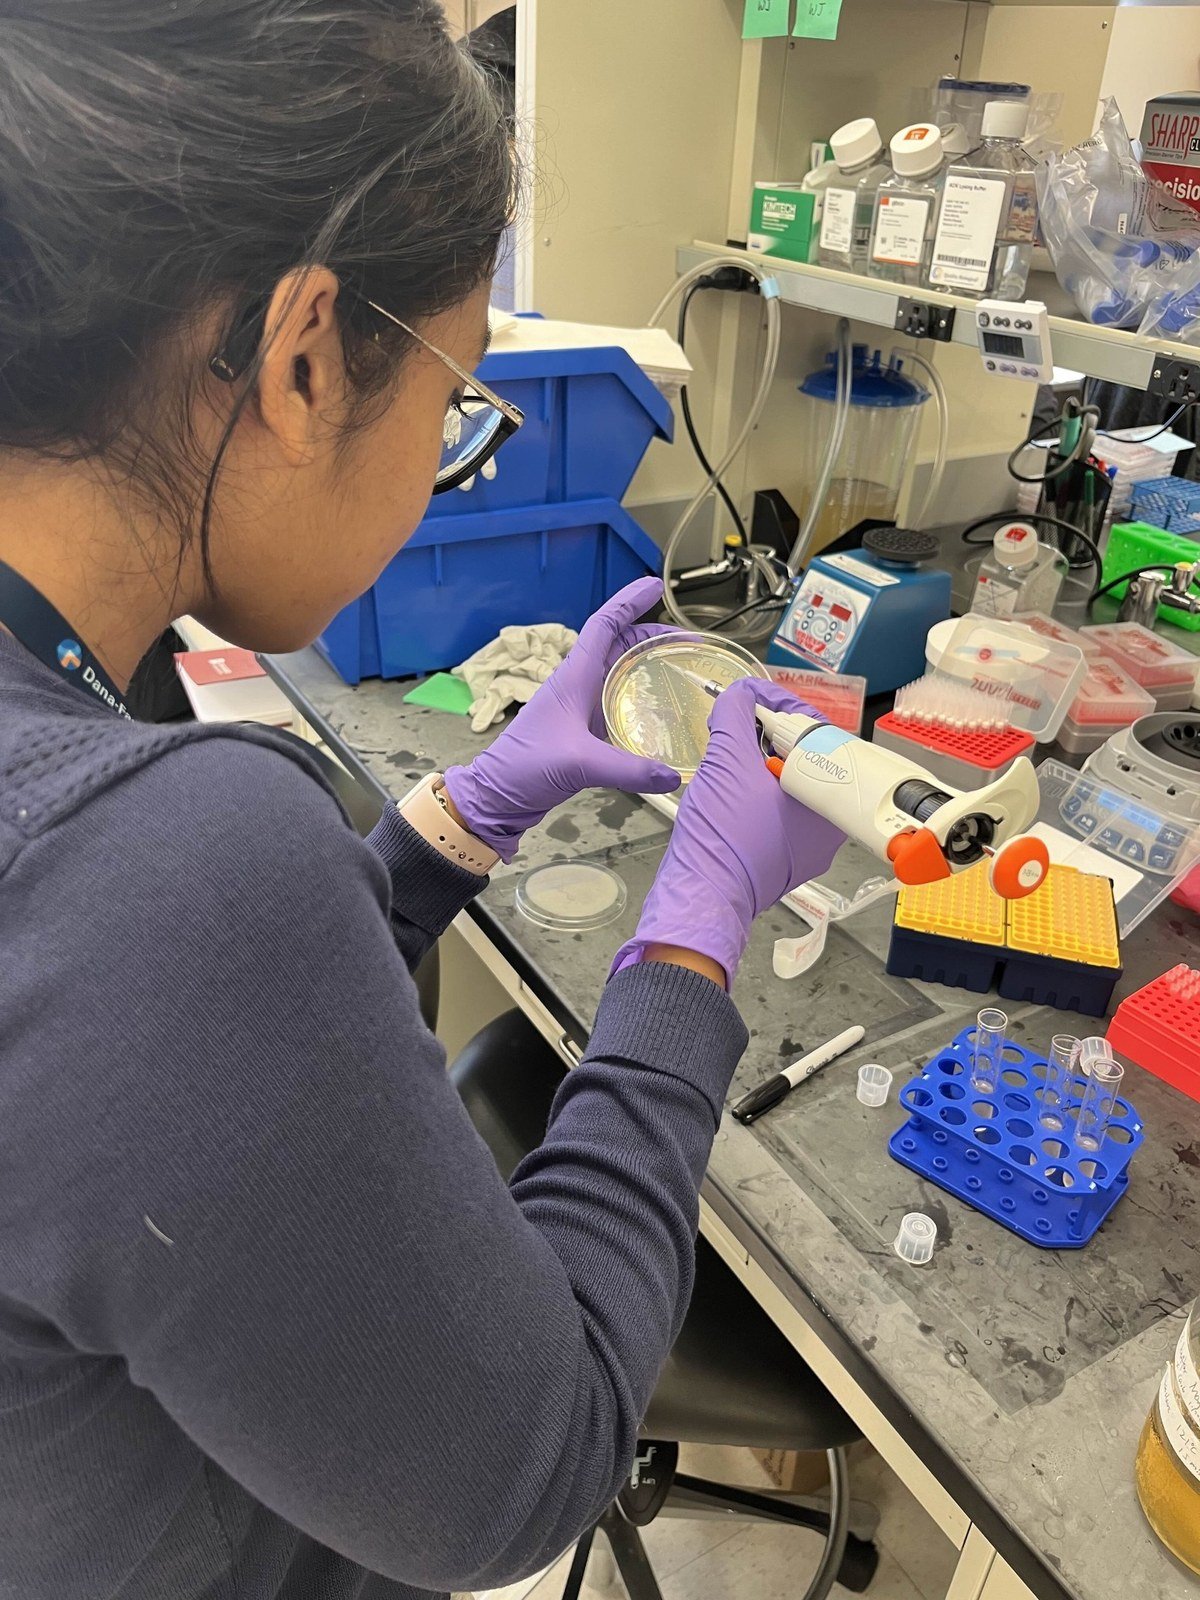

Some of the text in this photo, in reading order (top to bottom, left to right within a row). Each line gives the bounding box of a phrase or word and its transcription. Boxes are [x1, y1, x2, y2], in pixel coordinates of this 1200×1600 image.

[1147, 112, 1200, 160] SHARP
[82, 665, 135, 722] Dana-Fa
[804, 750, 848, 781] CORNING
